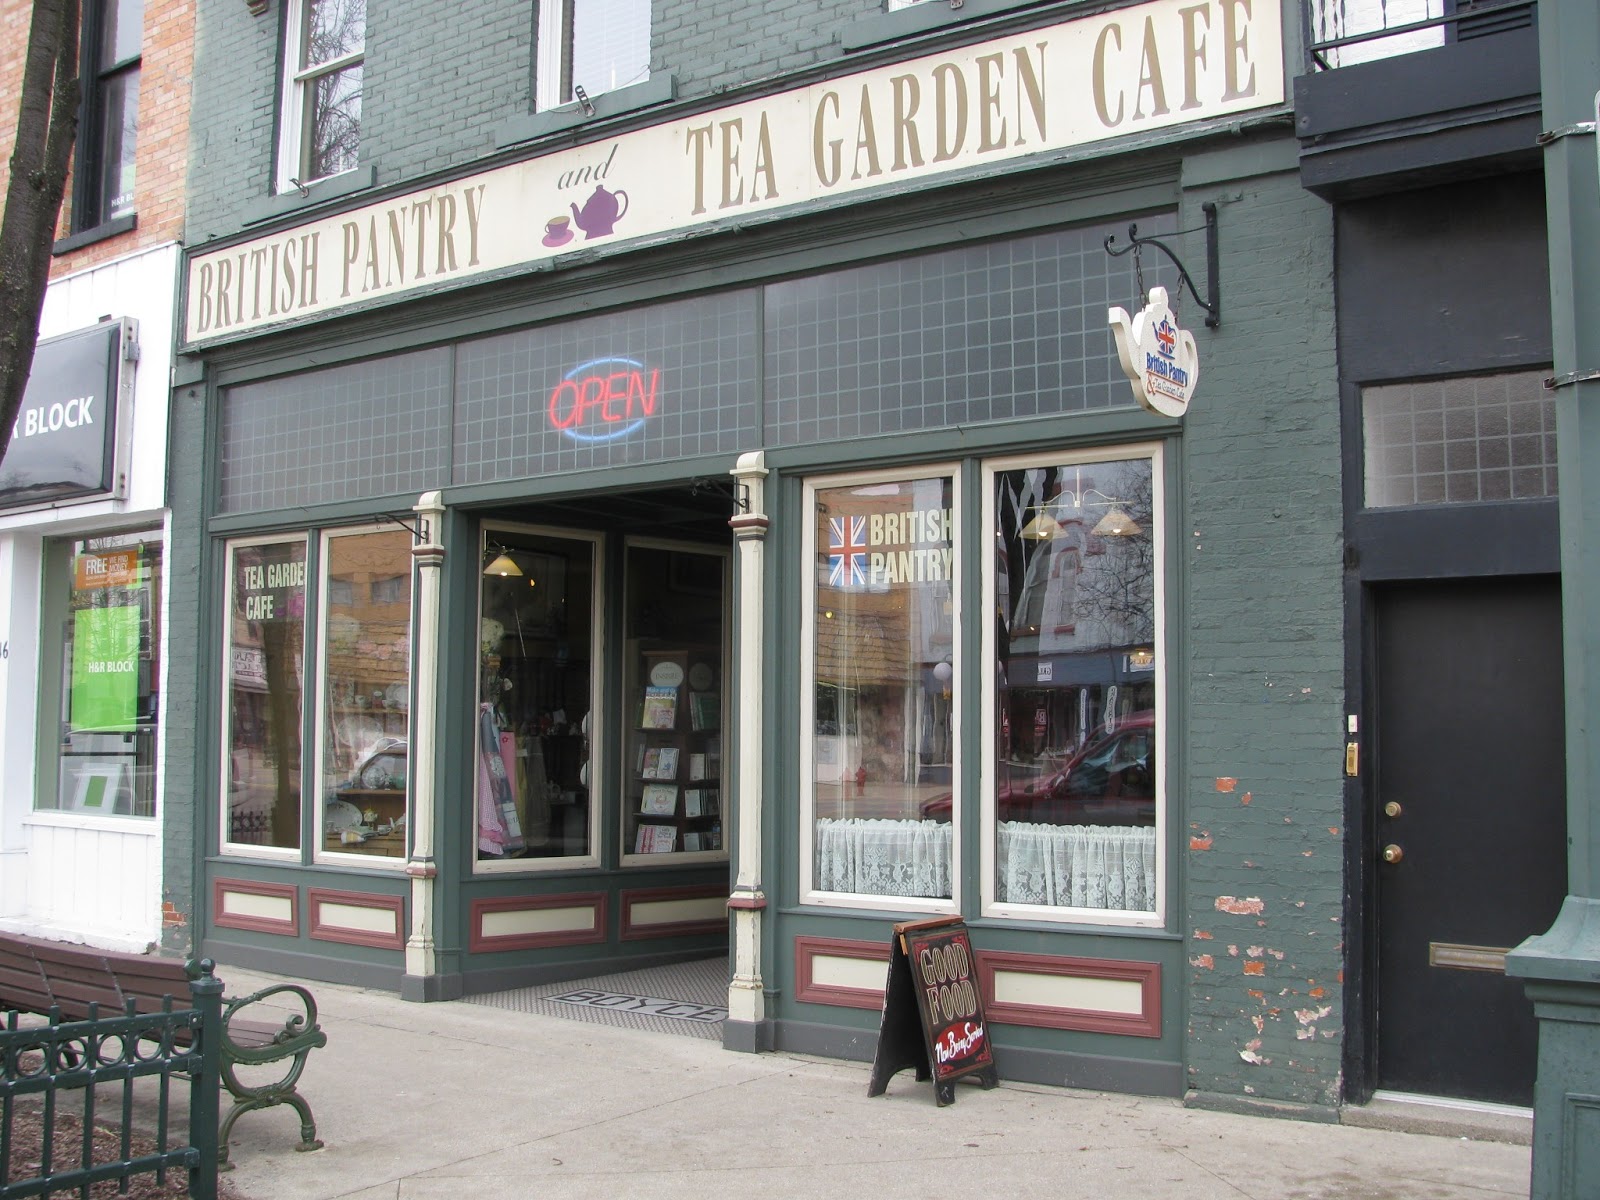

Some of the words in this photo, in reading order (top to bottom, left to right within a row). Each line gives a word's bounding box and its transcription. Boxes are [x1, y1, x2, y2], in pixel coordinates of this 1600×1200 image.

[197, 232, 320, 334] BRITISH
[340, 184, 486, 298] PANTRY
[558, 143, 618, 190] and
[686, 110, 779, 216] TEA
[813, 42, 1048, 188] GARDEN
[1092, 0, 1256, 128] CAFE
[1146, 352, 1168, 378] British
[1168, 361, 1188, 388] Pantry
[25, 396, 94, 437] BLOCK
[549, 368, 660, 430] OPEN
[870, 508, 953, 546] BRITISH
[85, 558, 108, 576] FREE
[244, 565, 265, 590] TEA
[870, 547, 953, 585] PANTRY
[246, 595, 274, 620] CAFE
[88, 661, 105, 673] H&R
[107, 660, 135, 672] BLOCK
[920, 943, 969, 986] GOOD
[556, 991, 729, 1021] BOYCE
[926, 979, 977, 1025] FOOD
